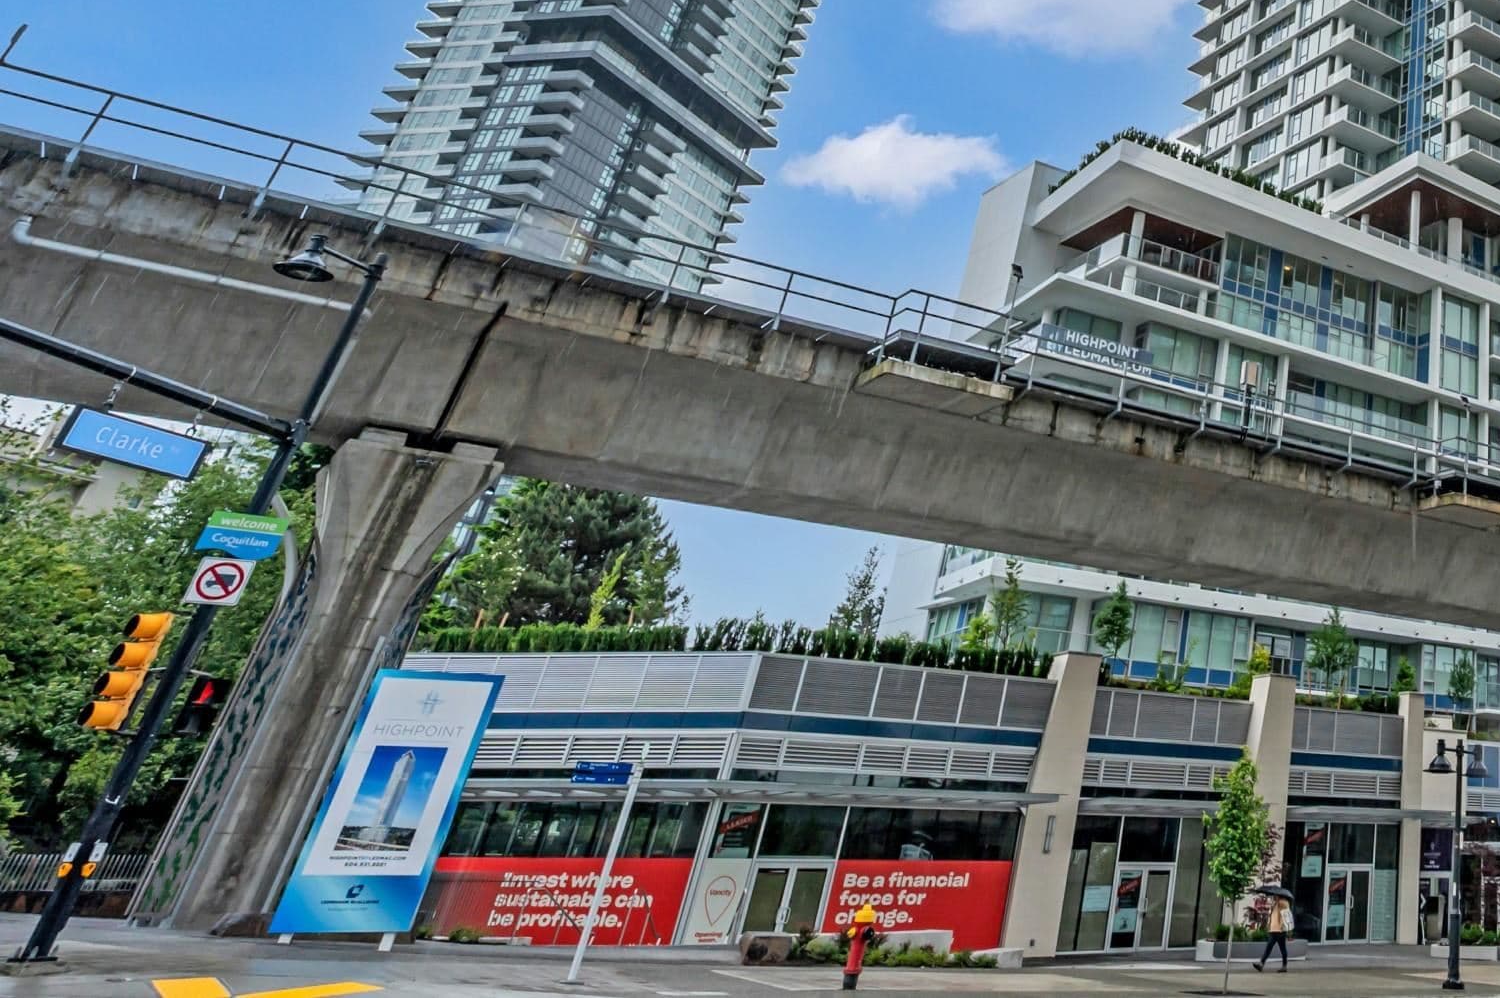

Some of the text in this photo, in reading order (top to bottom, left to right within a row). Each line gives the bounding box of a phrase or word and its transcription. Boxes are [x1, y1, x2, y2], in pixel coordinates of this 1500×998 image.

[1066, 330, 1139, 359] HIGHPOINT
[95, 426, 163, 459] Clarke
[221, 517, 277, 531] welcome
[373, 723, 464, 738] HIGHPOINT
[500, 871, 569, 888] Invest
[843, 872, 970, 888] Be a financial
[494, 890, 653, 908] sustainabe can
[839, 889, 927, 906] force for
[487, 909, 514, 926] be
[835, 909, 914, 928] chnge.
